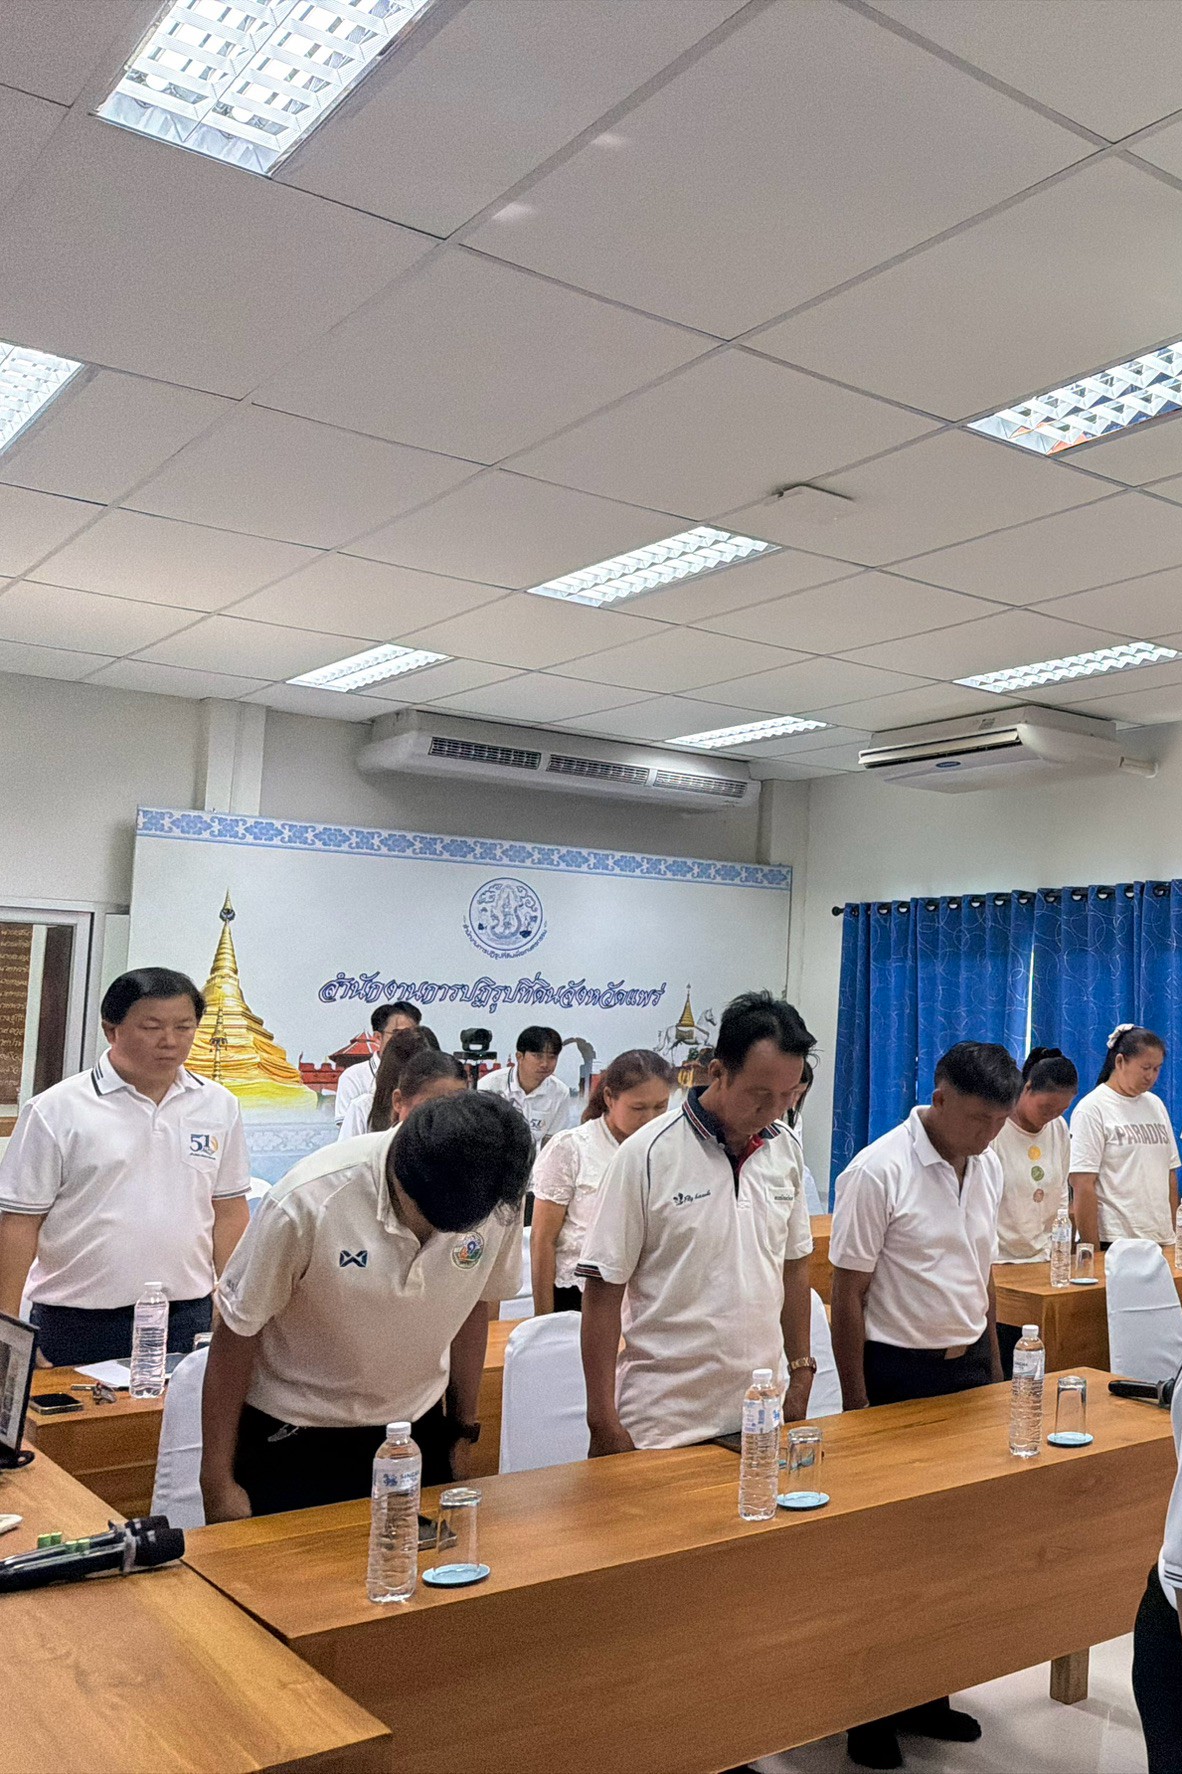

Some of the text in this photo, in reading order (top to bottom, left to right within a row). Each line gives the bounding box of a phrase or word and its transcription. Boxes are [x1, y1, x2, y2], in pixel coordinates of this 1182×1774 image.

[318, 971, 667, 1014] สำนักงานการปฏิรูปที่ดินจังหวัดแพร่
[190, 1133, 210, 1152] 51
[1114, 1122, 1170, 1146] PARADIS
